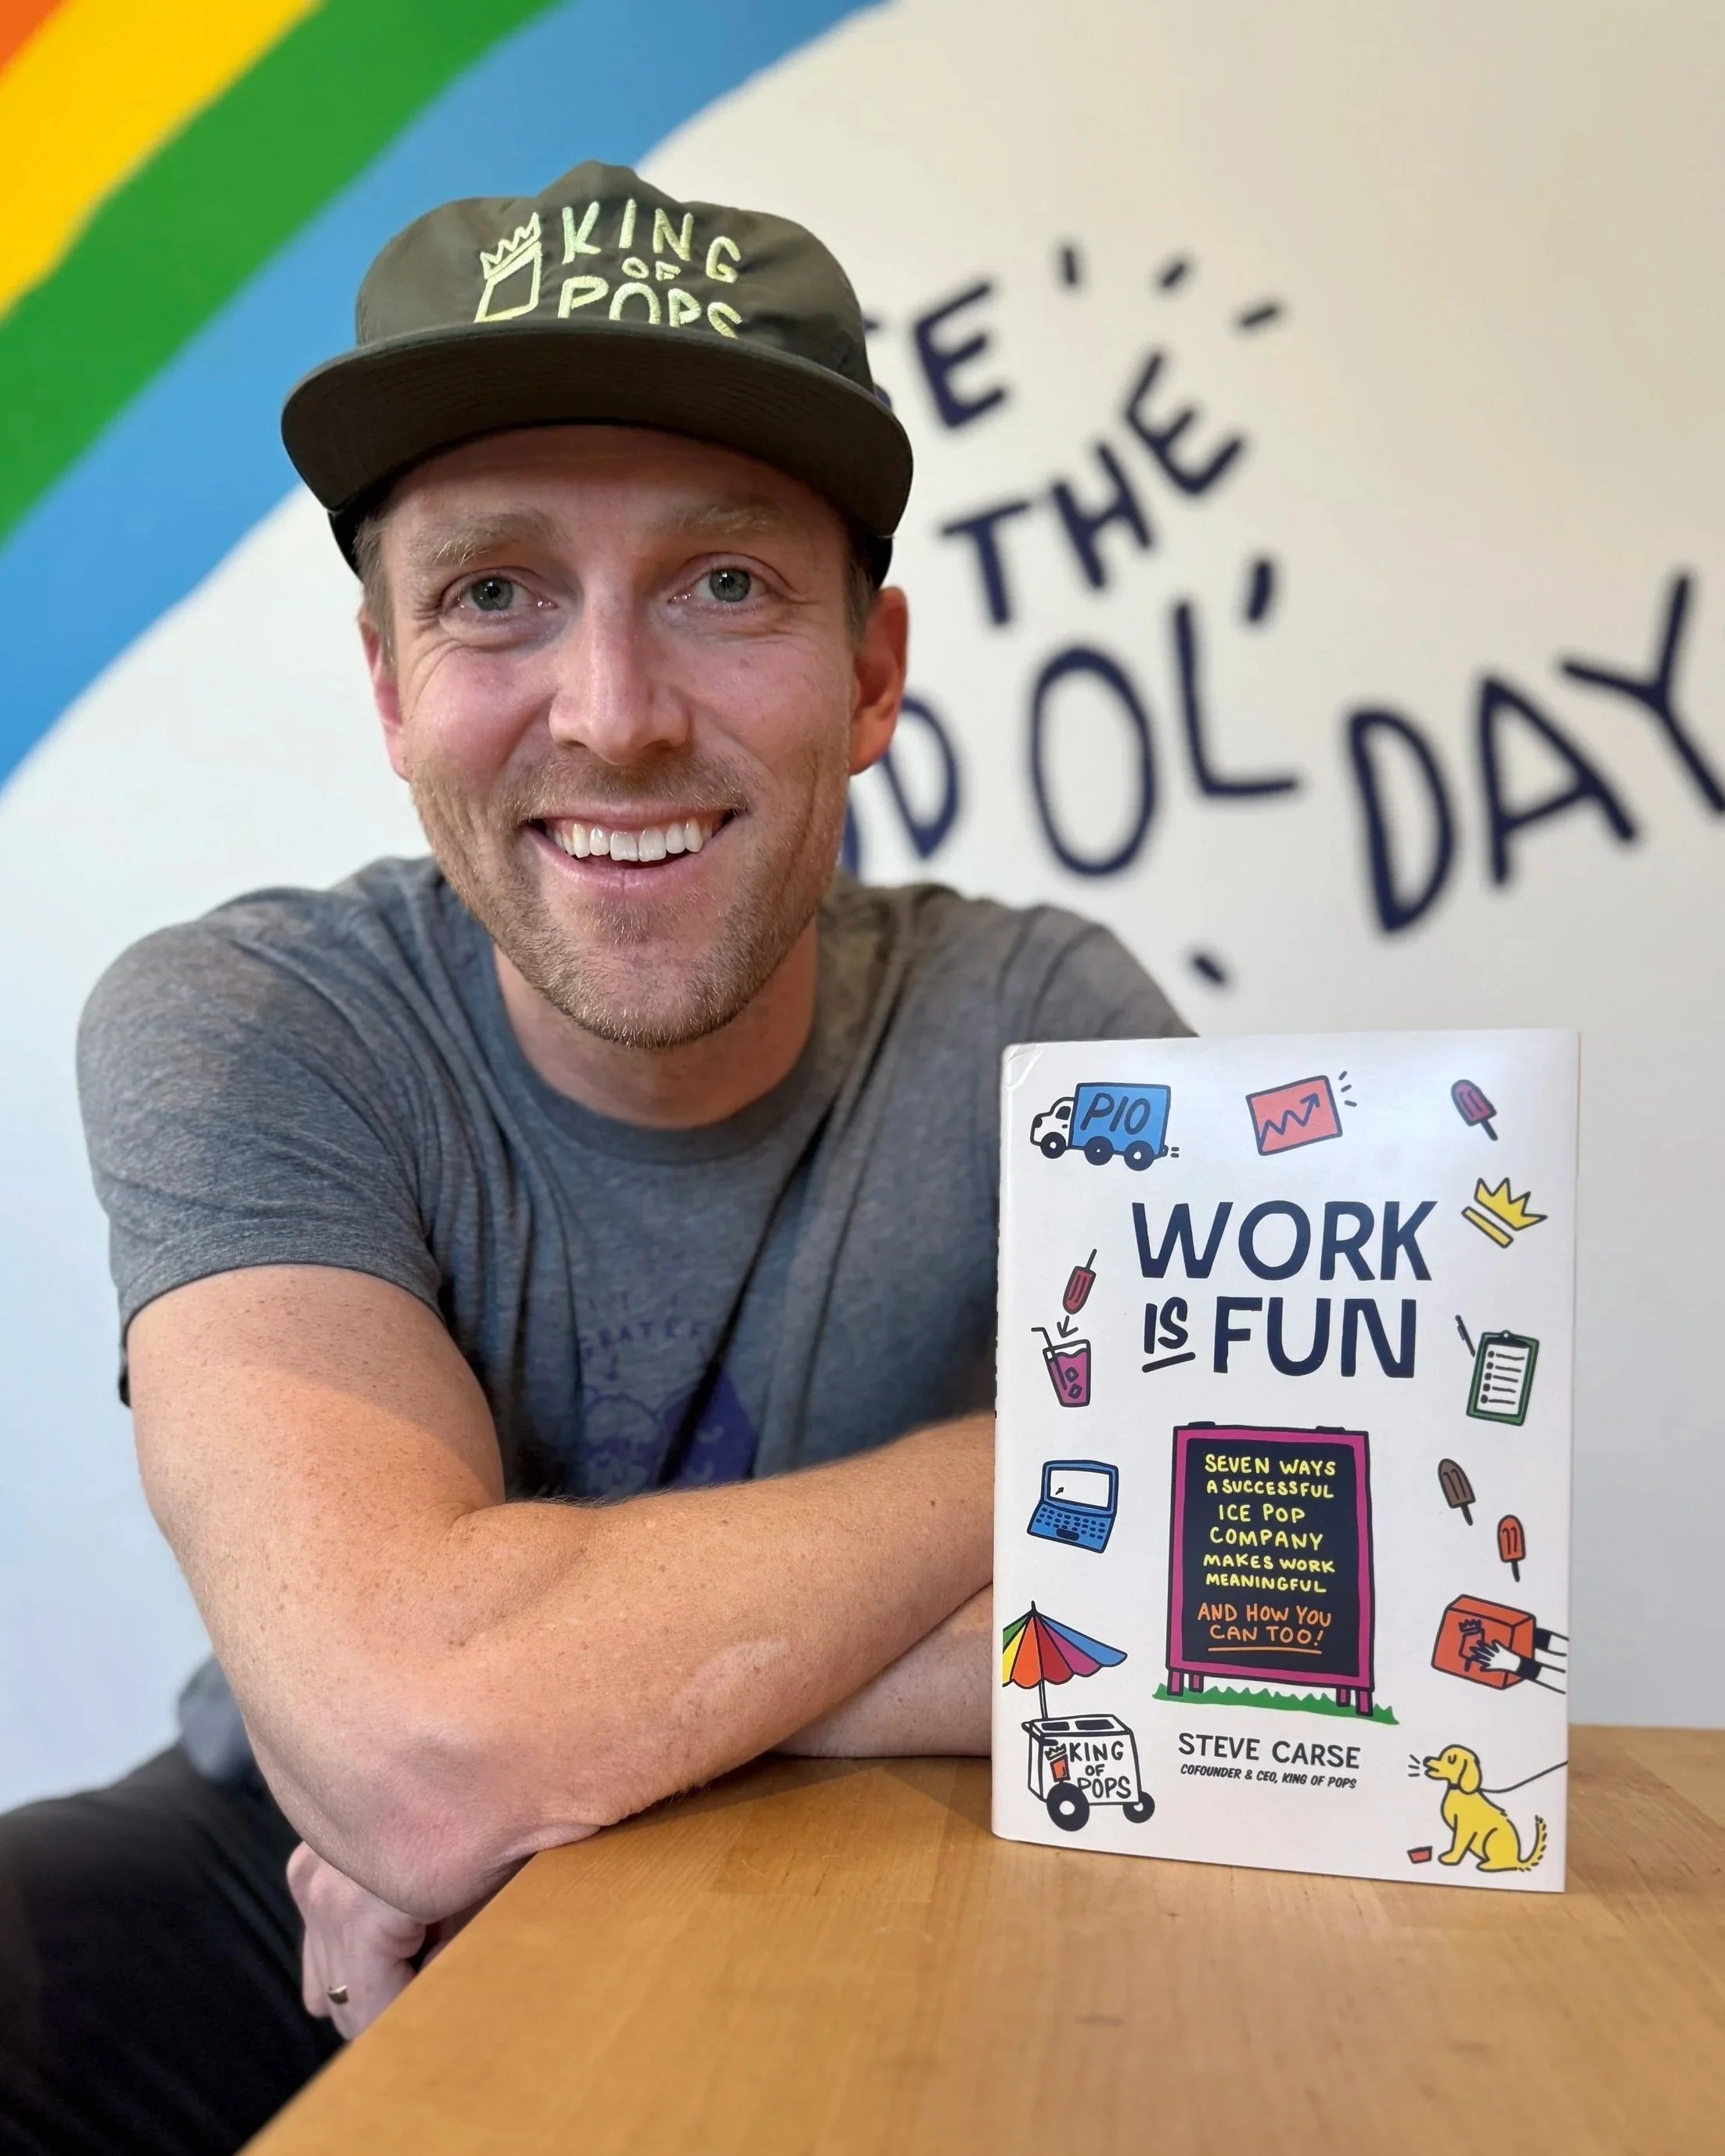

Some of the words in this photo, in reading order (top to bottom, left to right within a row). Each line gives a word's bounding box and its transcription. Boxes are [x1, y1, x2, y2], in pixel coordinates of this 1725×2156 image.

[562, 198, 742, 283] KING
[621, 256, 682, 282] OF
[942, 351, 1249, 628] THE
[1345, 571, 1725, 934] DAY
[1131, 1200, 1439, 1282] WORK
[1143, 1296, 1189, 1355] IS
[1213, 1296, 1417, 1379] FUN
[1205, 1454, 1269, 1474] SEVEN
[1280, 1459, 1336, 1477] WAYS
[1206, 1480, 1218, 1494] A
[1222, 1479, 1334, 1499] SUCCESSFUL
[1219, 1503, 1251, 1522] ICE
[1262, 1503, 1305, 1524] POP
[1209, 1527, 1323, 1551] COMPANY
[1203, 1553, 1273, 1570] MAKES
[1279, 1558, 1335, 1573] WORK
[1205, 1573, 1327, 1593] MEANINGFUL
[1197, 1603, 1237, 1622] AND
[1246, 1603, 1288, 1622] HOW
[1296, 1605, 1332, 1628] YOU
[1209, 1625, 1258, 1642] CAN
[1266, 1625, 1324, 1647] TOO!
[1069, 1740, 1124, 1762] KING
[1178, 1732, 1261, 1761] STEVE
[1272, 1740, 1361, 1769] CARSE
[1085, 1763, 1105, 1776] OF
[1180, 1763, 1242, 1780] COFOUNDER
[1244, 1769, 1253, 1780] &
[1256, 1770, 1278, 1783] CEO,
[1282, 1773, 1308, 1785] KING
[1310, 1775, 1325, 1787] OF
[1327, 1776, 1357, 1790] POPS
[1077, 1776, 1132, 1799] POPS
